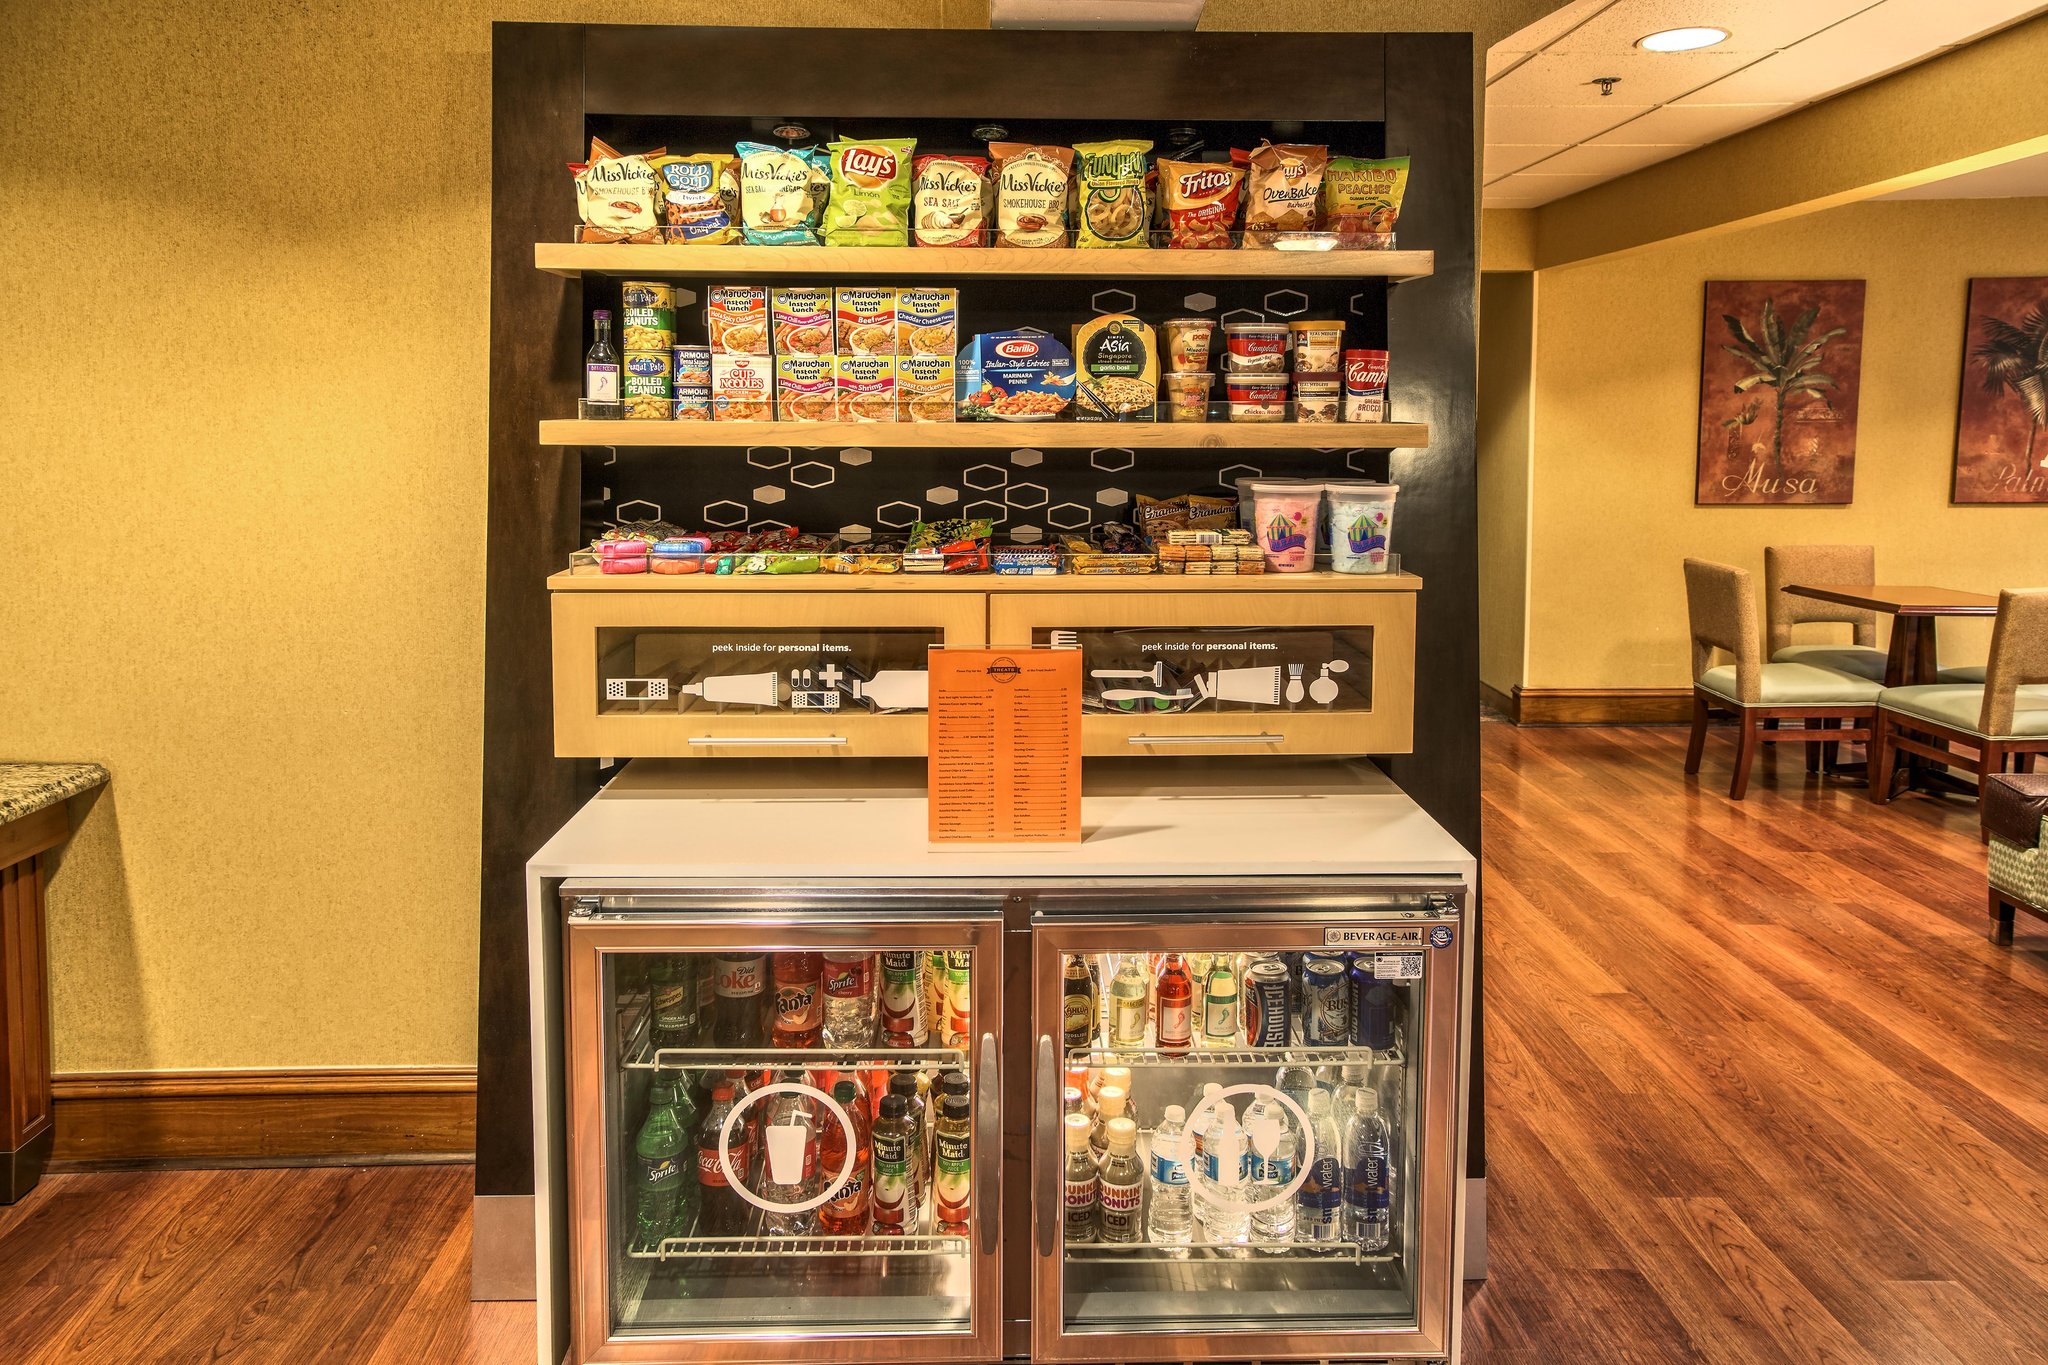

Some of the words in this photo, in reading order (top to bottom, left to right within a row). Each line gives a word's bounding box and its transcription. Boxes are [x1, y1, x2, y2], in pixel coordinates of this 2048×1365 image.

[844, 149, 894, 177] Lay's
[591, 165, 621, 182] Miss
[670, 164, 708, 176] ROLD
[742, 163, 769, 180] Miss
[768, 163, 808, 183] Vickie's
[667, 173, 710, 188] GOLD
[1327, 169, 1396, 184] HARIBO
[920, 174, 940, 191] Miss
[938, 171, 977, 195] Vickie's
[1001, 174, 1027, 192] Miss
[1025, 171, 1067, 196] Vickie's
[1179, 171, 1232, 198] Fritos
[1338, 184, 1391, 194] PEACHES
[924, 197, 938, 207] SEA
[942, 198, 960, 208] SALT
[1003, 198, 1046, 209] SMOKEHOUSE
[1049, 200, 1060, 209] BBQ
[1198, 203, 1226, 217] ORIGINAL
[689, 218, 721, 235] Original
[721, 290, 762, 298] Maruchan
[786, 292, 826, 300] Maruchan
[849, 291, 891, 299] Maruchan
[909, 293, 950, 301] Maruchan
[625, 309, 654, 317] BOILED
[813, 313, 829, 322] Shrimp
[624, 317, 658, 325] PEANUTS
[858, 316, 875, 324] Beef
[898, 312, 921, 323] Cheddar
[922, 317, 942, 325] Cheese
[1006, 344, 1035, 354] Barilla
[1099, 338, 1130, 353] Asia
[1247, 342, 1279, 354] Campbell's
[680, 351, 710, 359] ARMOUR
[790, 360, 830, 368] Maruchan
[849, 360, 889, 368] Maruchan
[985, 359, 1025, 370] Italian-Style
[730, 369, 755, 379] CUP
[632, 377, 662, 386] BOILED
[720, 378, 764, 389] NOODLES
[817, 381, 833, 390] Shrimp
[898, 380, 917, 389] Roast
[917, 383, 941, 391] Chicken
[628, 386, 666, 394] PEANUTS
[858, 383, 883, 392] Shrimp
[1249, 391, 1279, 400] Campbell's
[1721, 458, 1817, 497] Musa
[712, 643, 733, 653] peek
[736, 643, 761, 652] inside
[763, 643, 776, 652] for
[778, 643, 819, 653] personal
[822, 643, 852, 652] items.
[1142, 642, 1162, 652] peek
[1164, 642, 1189, 651] inside
[1192, 642, 1205, 650] for
[1206, 642, 1247, 652] personal
[1249, 642, 1278, 650] items.
[1343, 932, 1418, 941] BEVERAGE-AIR
[885, 958, 906, 967] Maid
[955, 959, 969, 967] Ma
[737, 967, 755, 975] Diet
[828, 976, 855, 990] Sprite
[1351, 981, 1359, 1018] LIGHT
[1328, 999, 1348, 1011] BUS
[1351, 1022, 1359, 1041] BUD
[874, 1140, 901, 1152] Minute
[939, 1139, 968, 1149] Minute
[878, 1151, 898, 1160] Maid
[942, 1148, 964, 1158] Maid
[649, 1164, 676, 1181] Sprite
[1099, 1191, 1140, 1209] DONUTS
